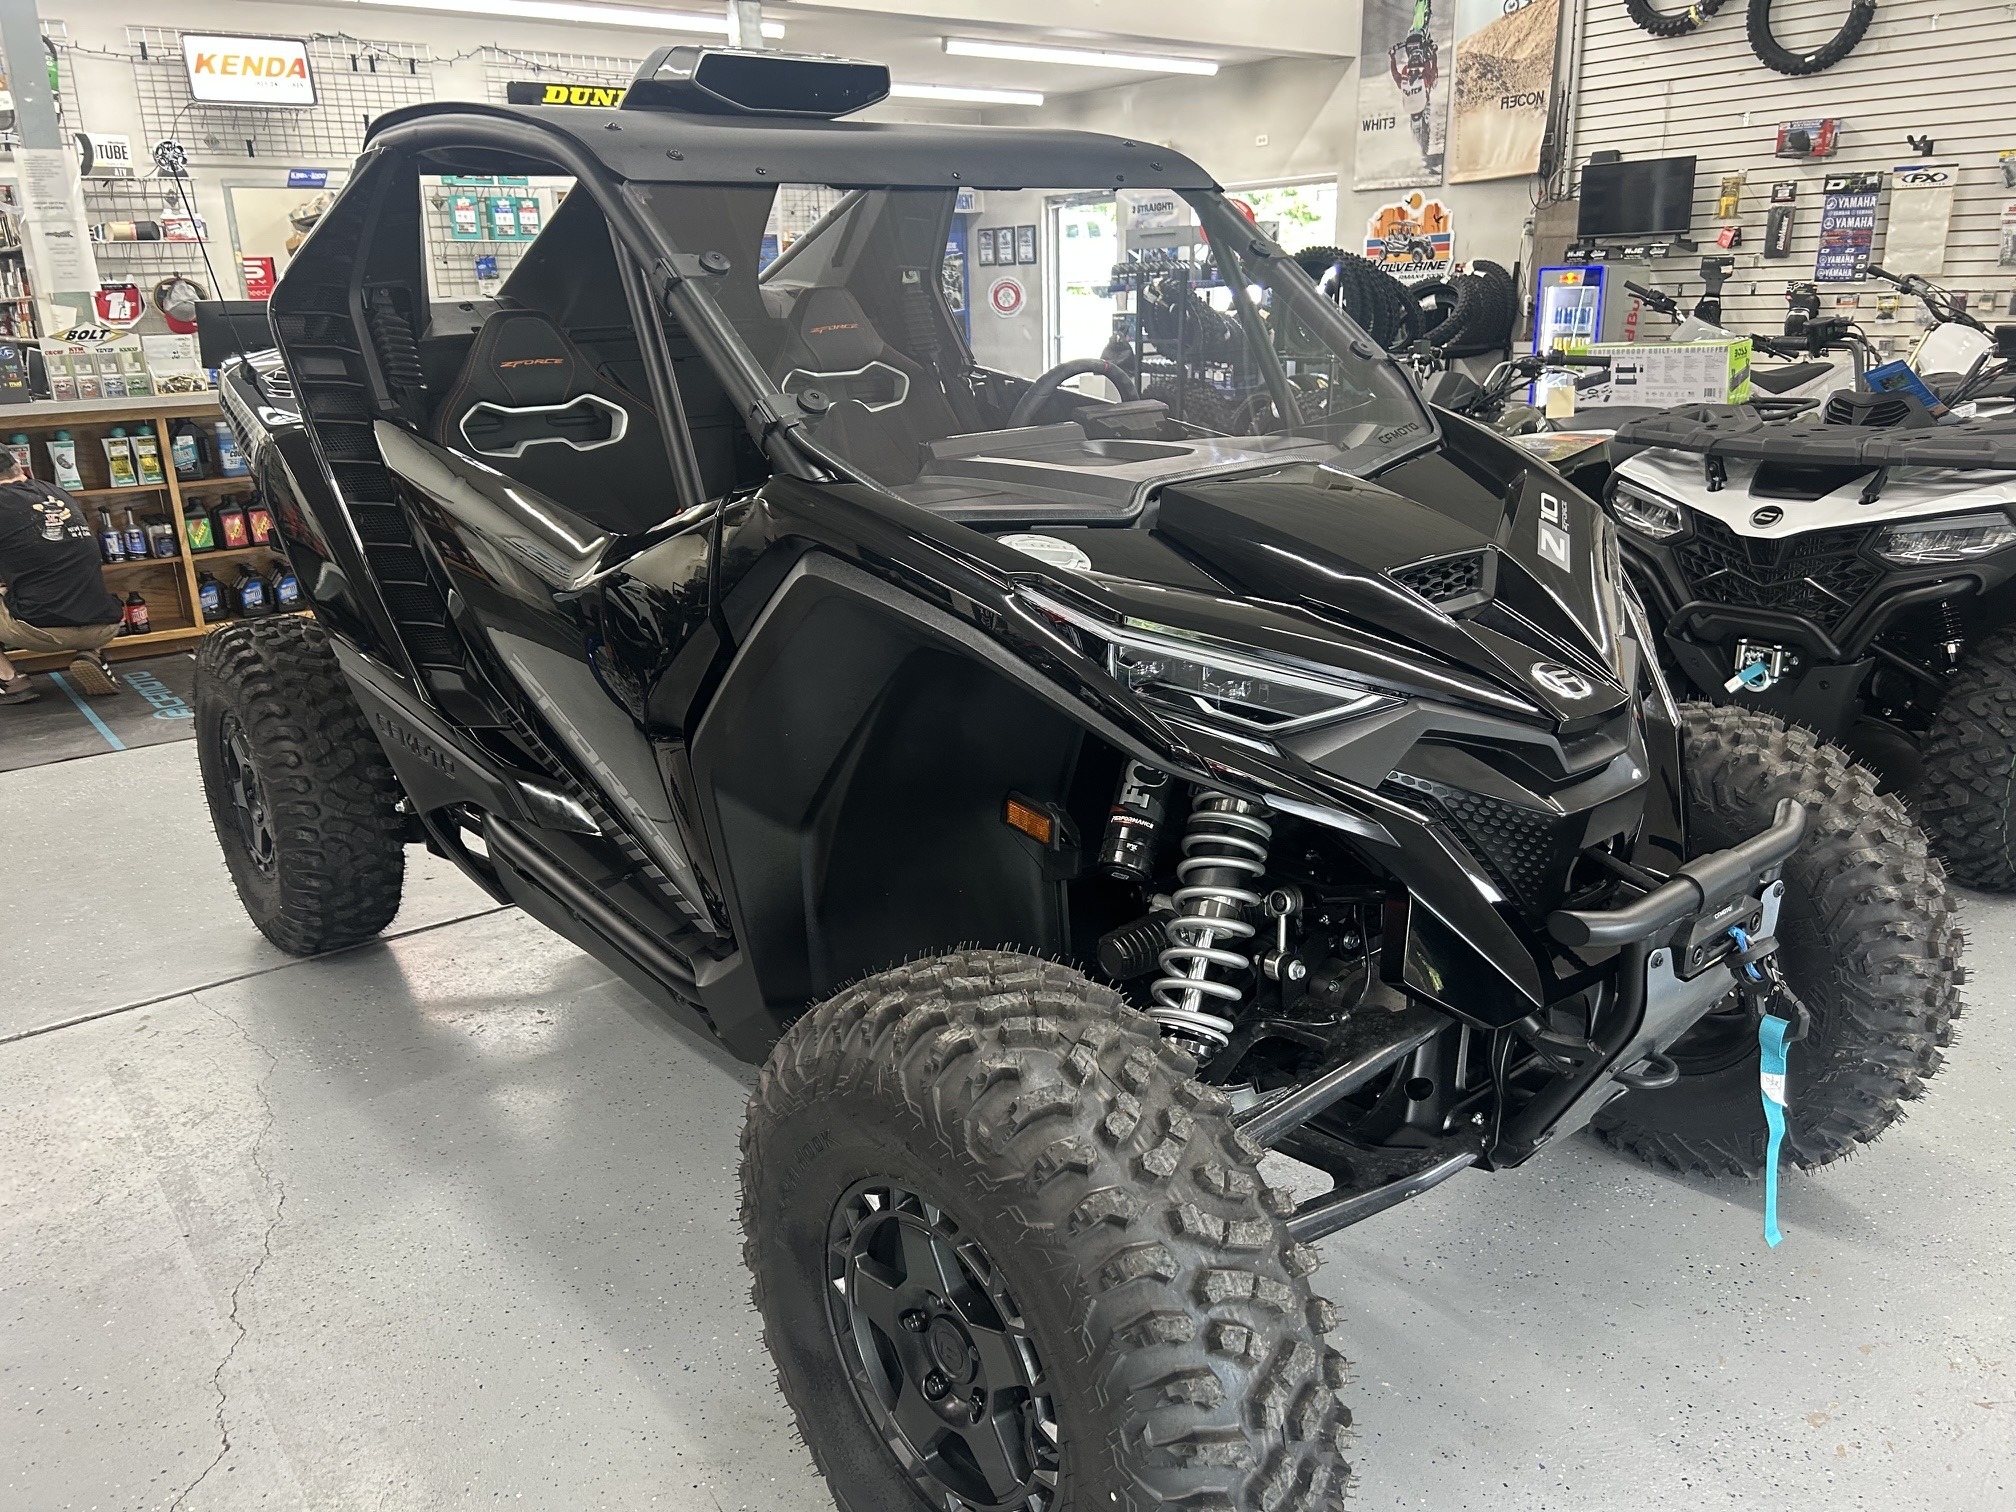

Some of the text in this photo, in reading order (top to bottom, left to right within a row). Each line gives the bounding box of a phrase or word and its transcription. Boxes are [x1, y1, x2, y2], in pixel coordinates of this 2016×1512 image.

[194, 53, 307, 79] KENDA
[97, 144, 129, 160] TUBE
[1838, 196, 1877, 208] YAMAHA
[1835, 217, 1873, 228] YAMAHA
[1827, 255, 1855, 263] YAMAHA
[1825, 269, 1852, 277] YAMAHA
[65, 329, 110, 341] BOLT
[500, 358, 564, 368] ZFORCE
[1378, 422, 1419, 444] CFMOTO
[509, 653, 685, 870] ZFORCE
[1111, 816, 1154, 829] PERFORMANCE
